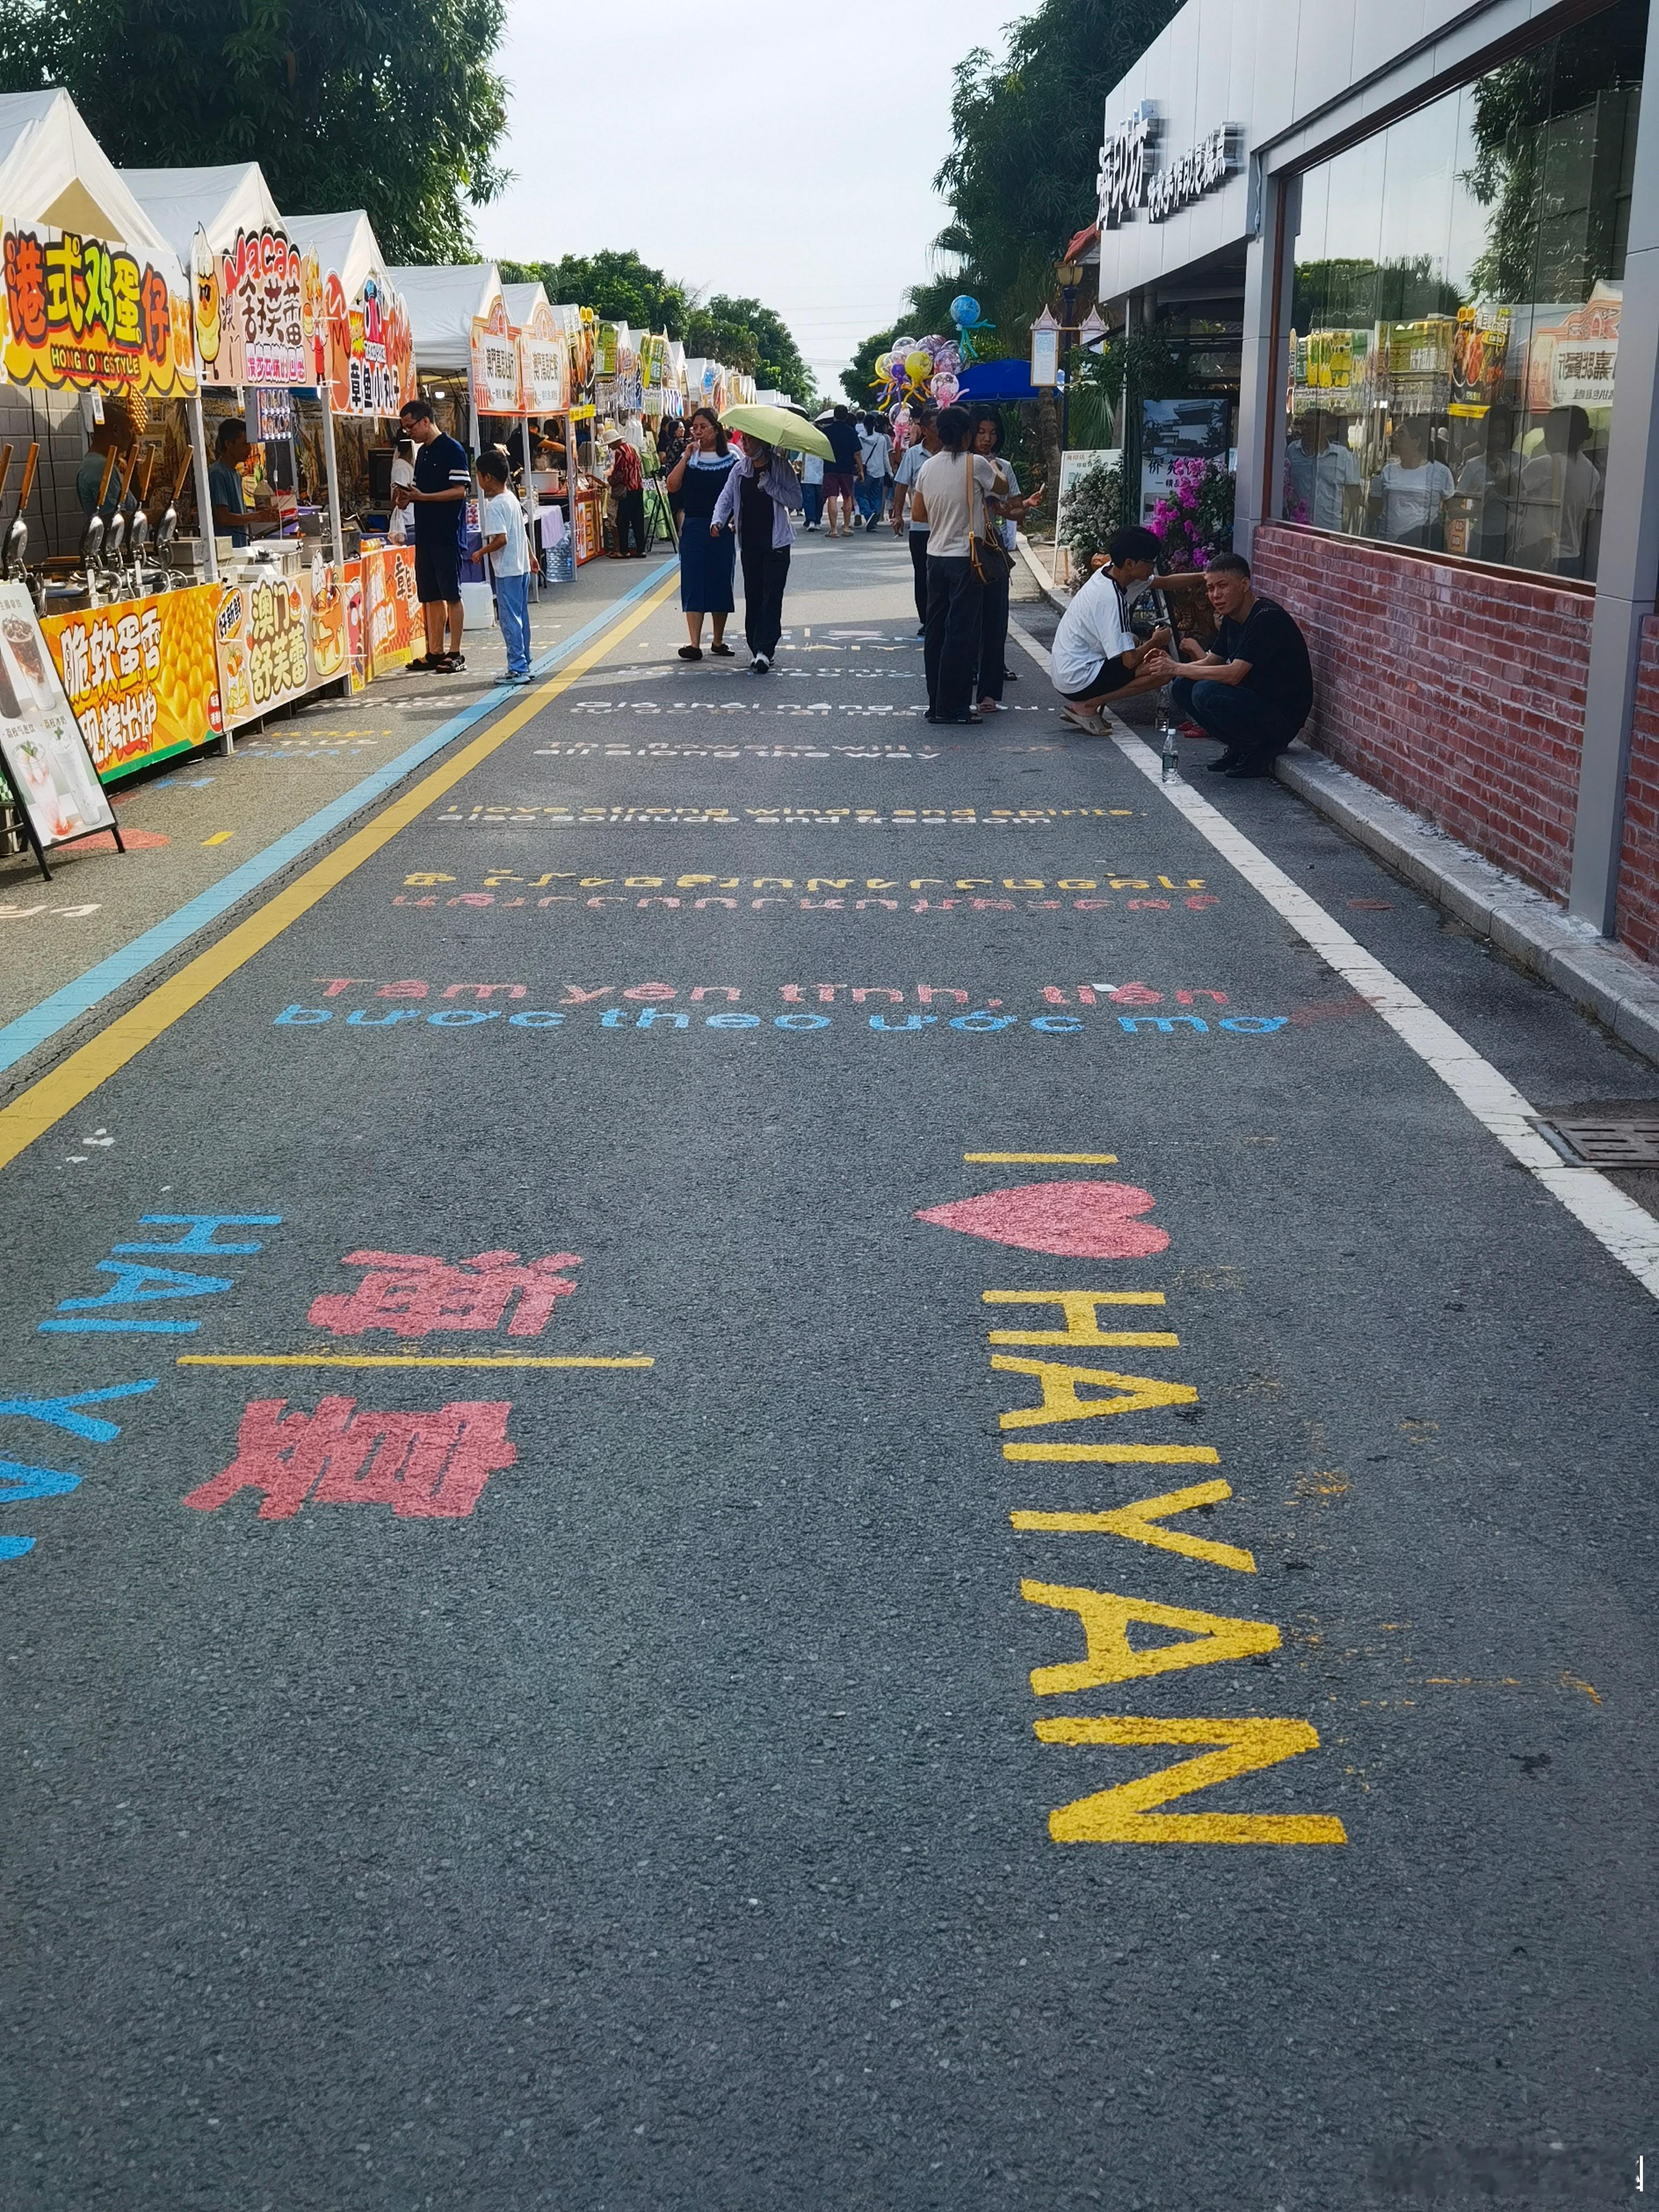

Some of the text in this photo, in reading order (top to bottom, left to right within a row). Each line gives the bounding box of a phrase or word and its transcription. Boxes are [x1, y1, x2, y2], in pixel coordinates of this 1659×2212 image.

[3, 233, 169, 359] 港式鸡蛋仔
[238, 275, 302, 345] 舒芙蕾
[350, 362, 400, 409] 章鱼小丸子
[252, 582, 290, 639] 澳门
[60, 606, 161, 703] 脆软蛋香
[250, 624, 308, 703] 舒芙蕾
[79, 686, 157, 765] 现烤出炉
[604, 748, 741, 758] along
[756, 750, 831, 758] the
[844, 752, 941, 760] way
[436, 813, 1051, 824] also solitude and freedom
[471, 805, 568, 814] love
[583, 806, 729, 819] strong
[746, 807, 878, 816] winds
[894, 807, 976, 816] and
[599, 1007, 832, 1031] theo
[1117, 1015, 1289, 1034] mơ
[963, 1151, 1119, 1165] I
[37, 1213, 282, 1334] HAI
[982, 1290, 1349, 1845] HAIYAN
